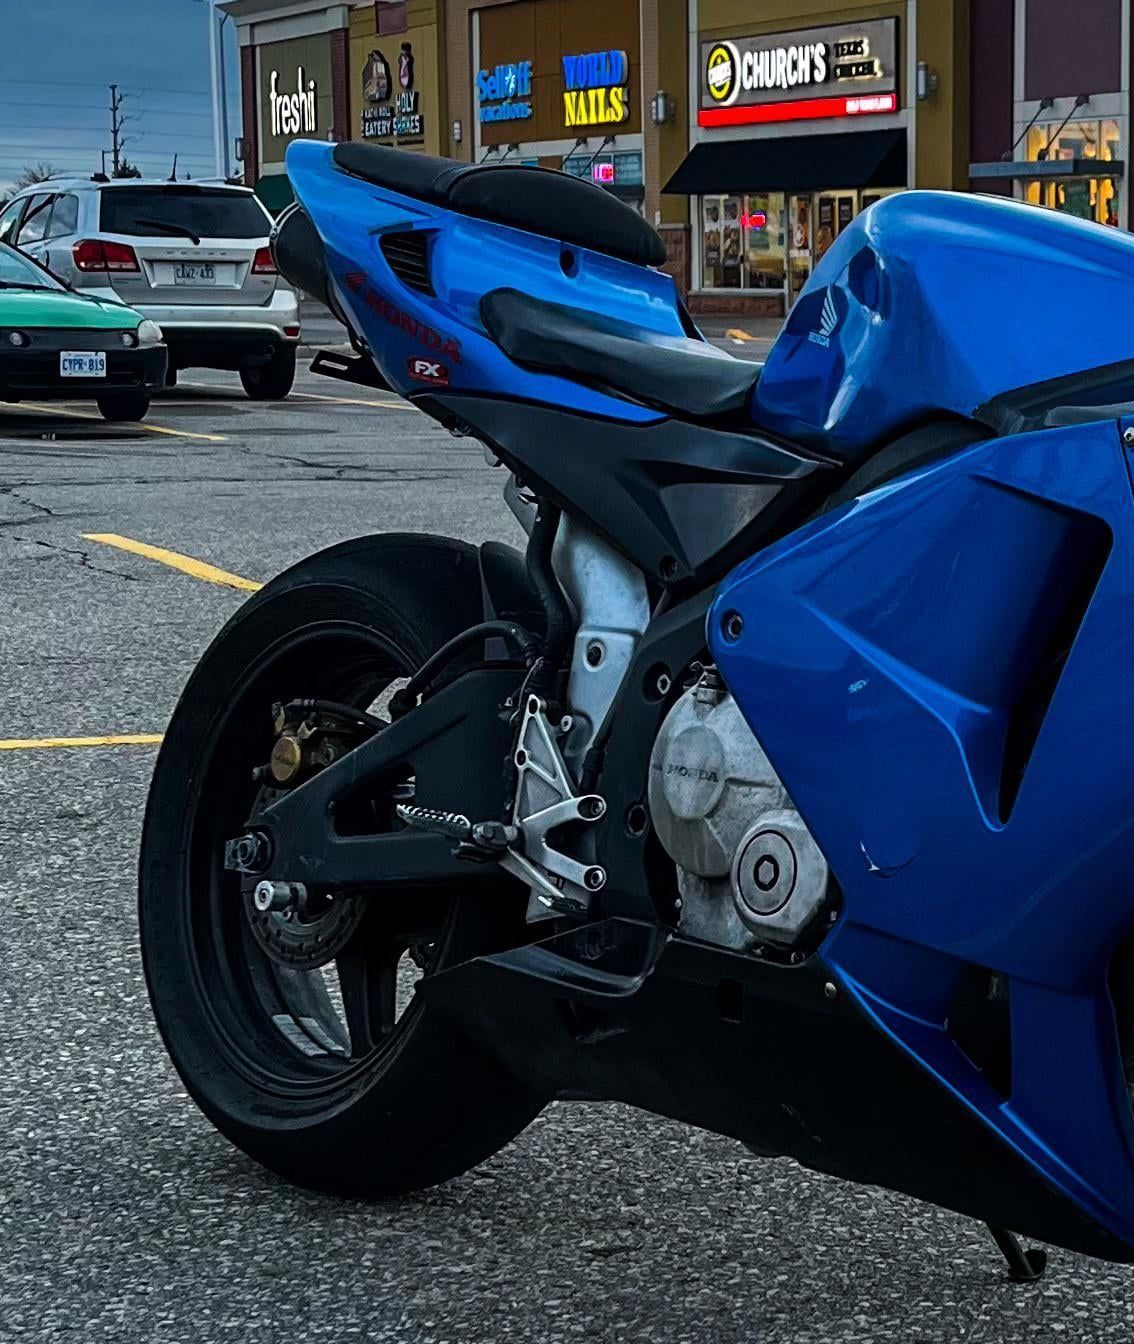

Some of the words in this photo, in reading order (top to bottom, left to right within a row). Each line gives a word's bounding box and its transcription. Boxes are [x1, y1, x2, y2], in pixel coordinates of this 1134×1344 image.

[562, 49, 627, 89] WORLD
[741, 42, 827, 90] CHURCH'S
[269, 66, 316, 137] freshii
[396, 90, 415, 113] HOLY
[563, 87, 625, 127] NAILS
[365, 119, 391, 137] EATERY
[62, 357, 84, 371] CYPR
[88, 357, 105, 371] 819
[414, 360, 441, 377] FX
